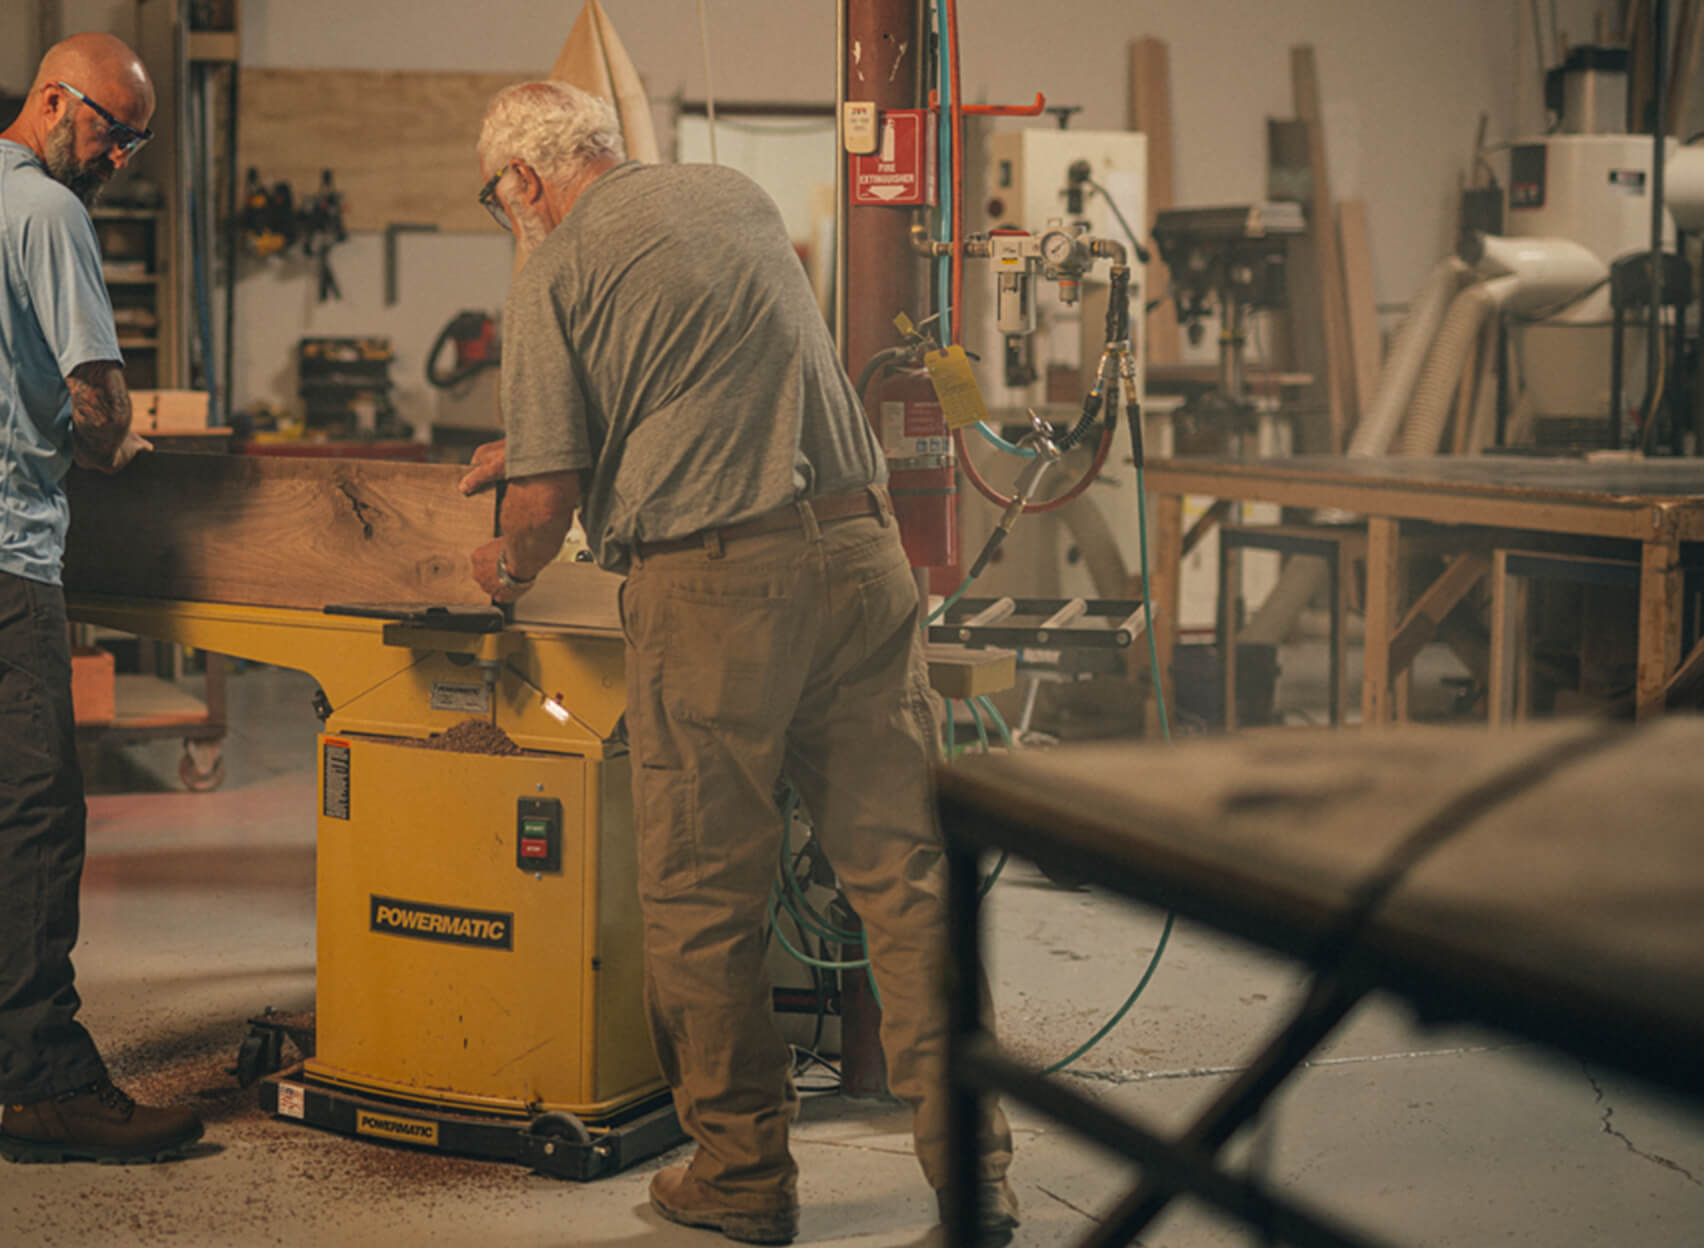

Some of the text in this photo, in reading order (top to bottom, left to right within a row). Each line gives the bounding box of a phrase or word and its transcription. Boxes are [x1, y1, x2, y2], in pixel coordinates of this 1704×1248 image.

[878, 163, 896, 172] FIRE
[859, 174, 914, 184] EXTINGUISHER
[375, 905, 505, 941] POWERMATIC
[361, 1115, 433, 1139] POWERMATIC
